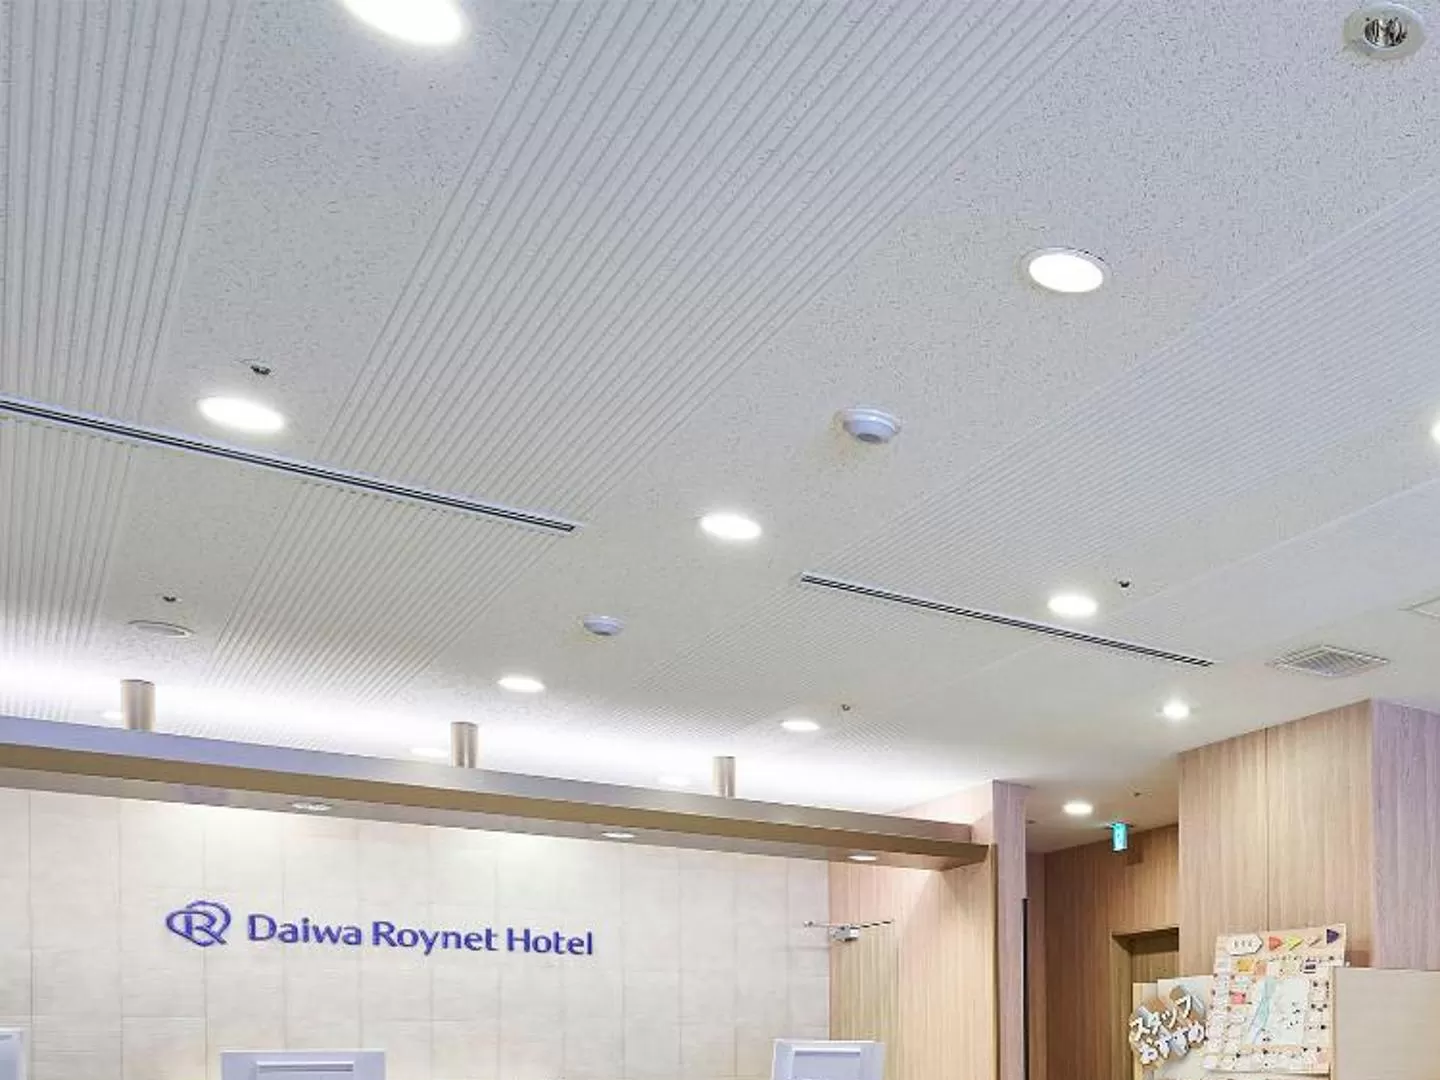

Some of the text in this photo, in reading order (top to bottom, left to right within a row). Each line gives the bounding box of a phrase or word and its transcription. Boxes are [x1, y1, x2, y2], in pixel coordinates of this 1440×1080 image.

[247, 914, 594, 956] Daiwa Roynet Hotel
